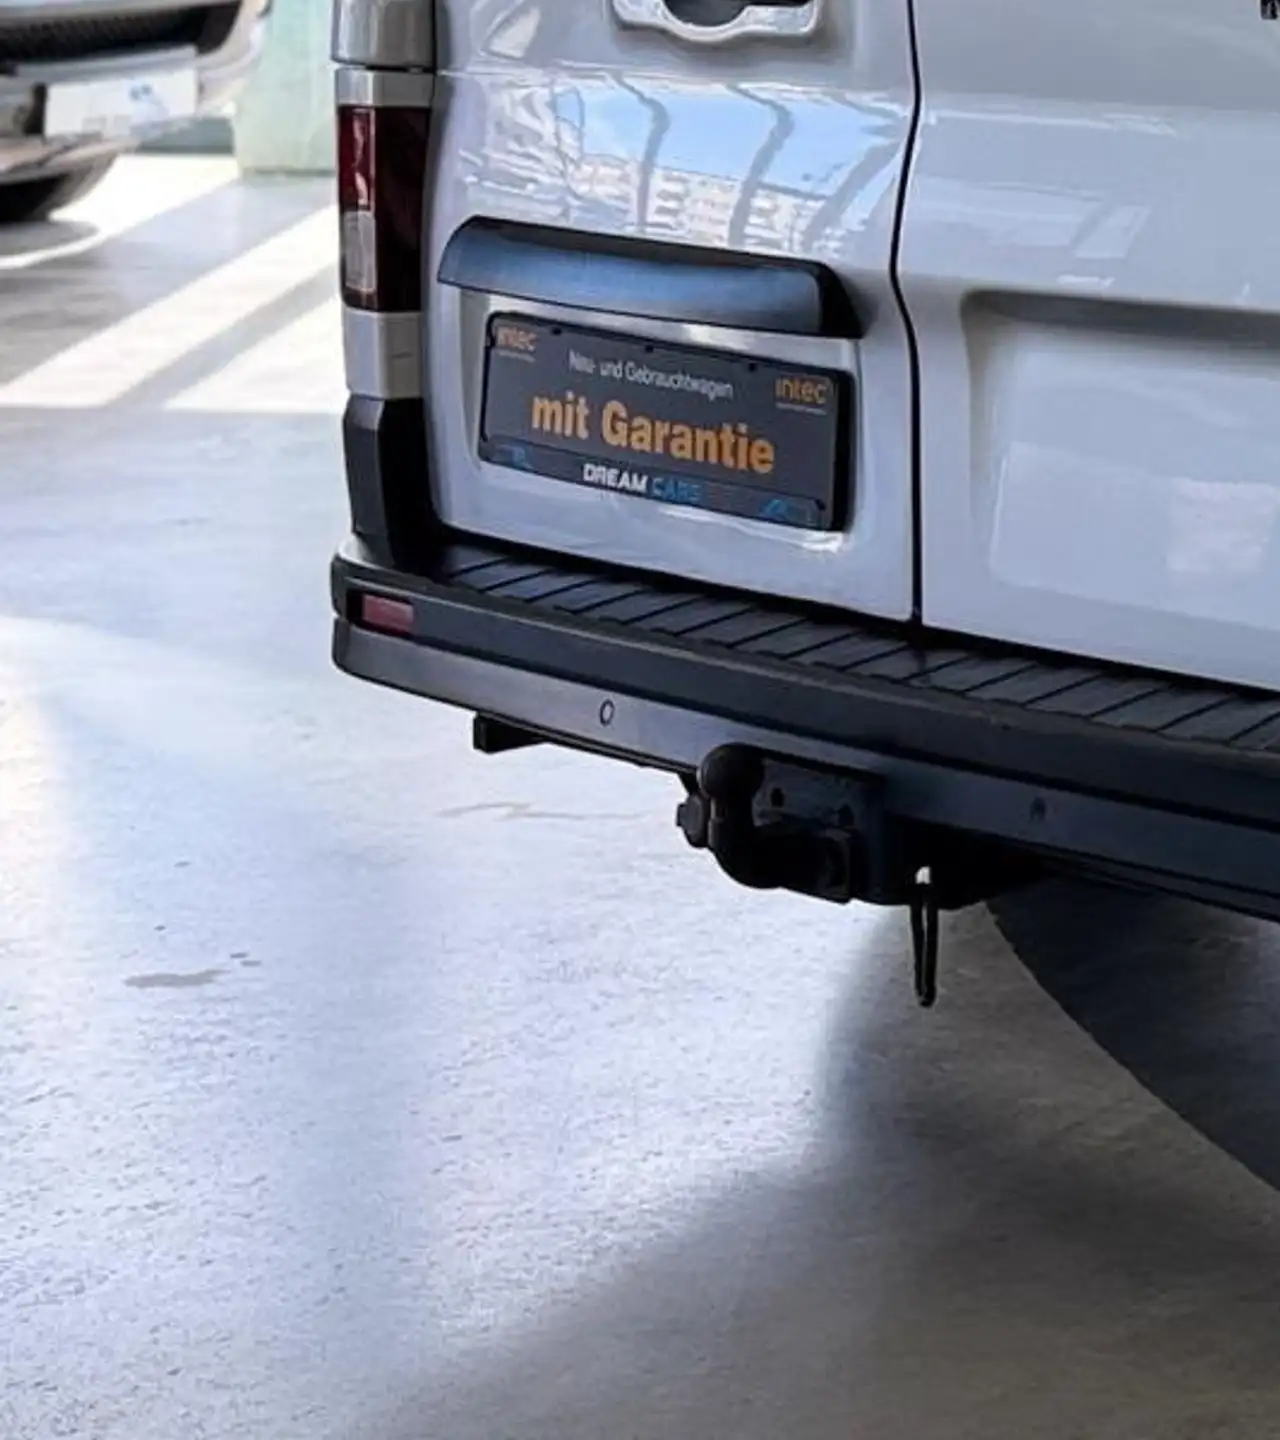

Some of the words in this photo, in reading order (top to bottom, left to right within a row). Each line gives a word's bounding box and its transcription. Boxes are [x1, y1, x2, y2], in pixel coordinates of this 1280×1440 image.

[600, 360, 623, 379] und
[624, 361, 734, 401] Gebrauchtwagen
[532, 390, 589, 440] mit
[602, 400, 775, 475] Garantie
[583, 462, 647, 494] DREAM
